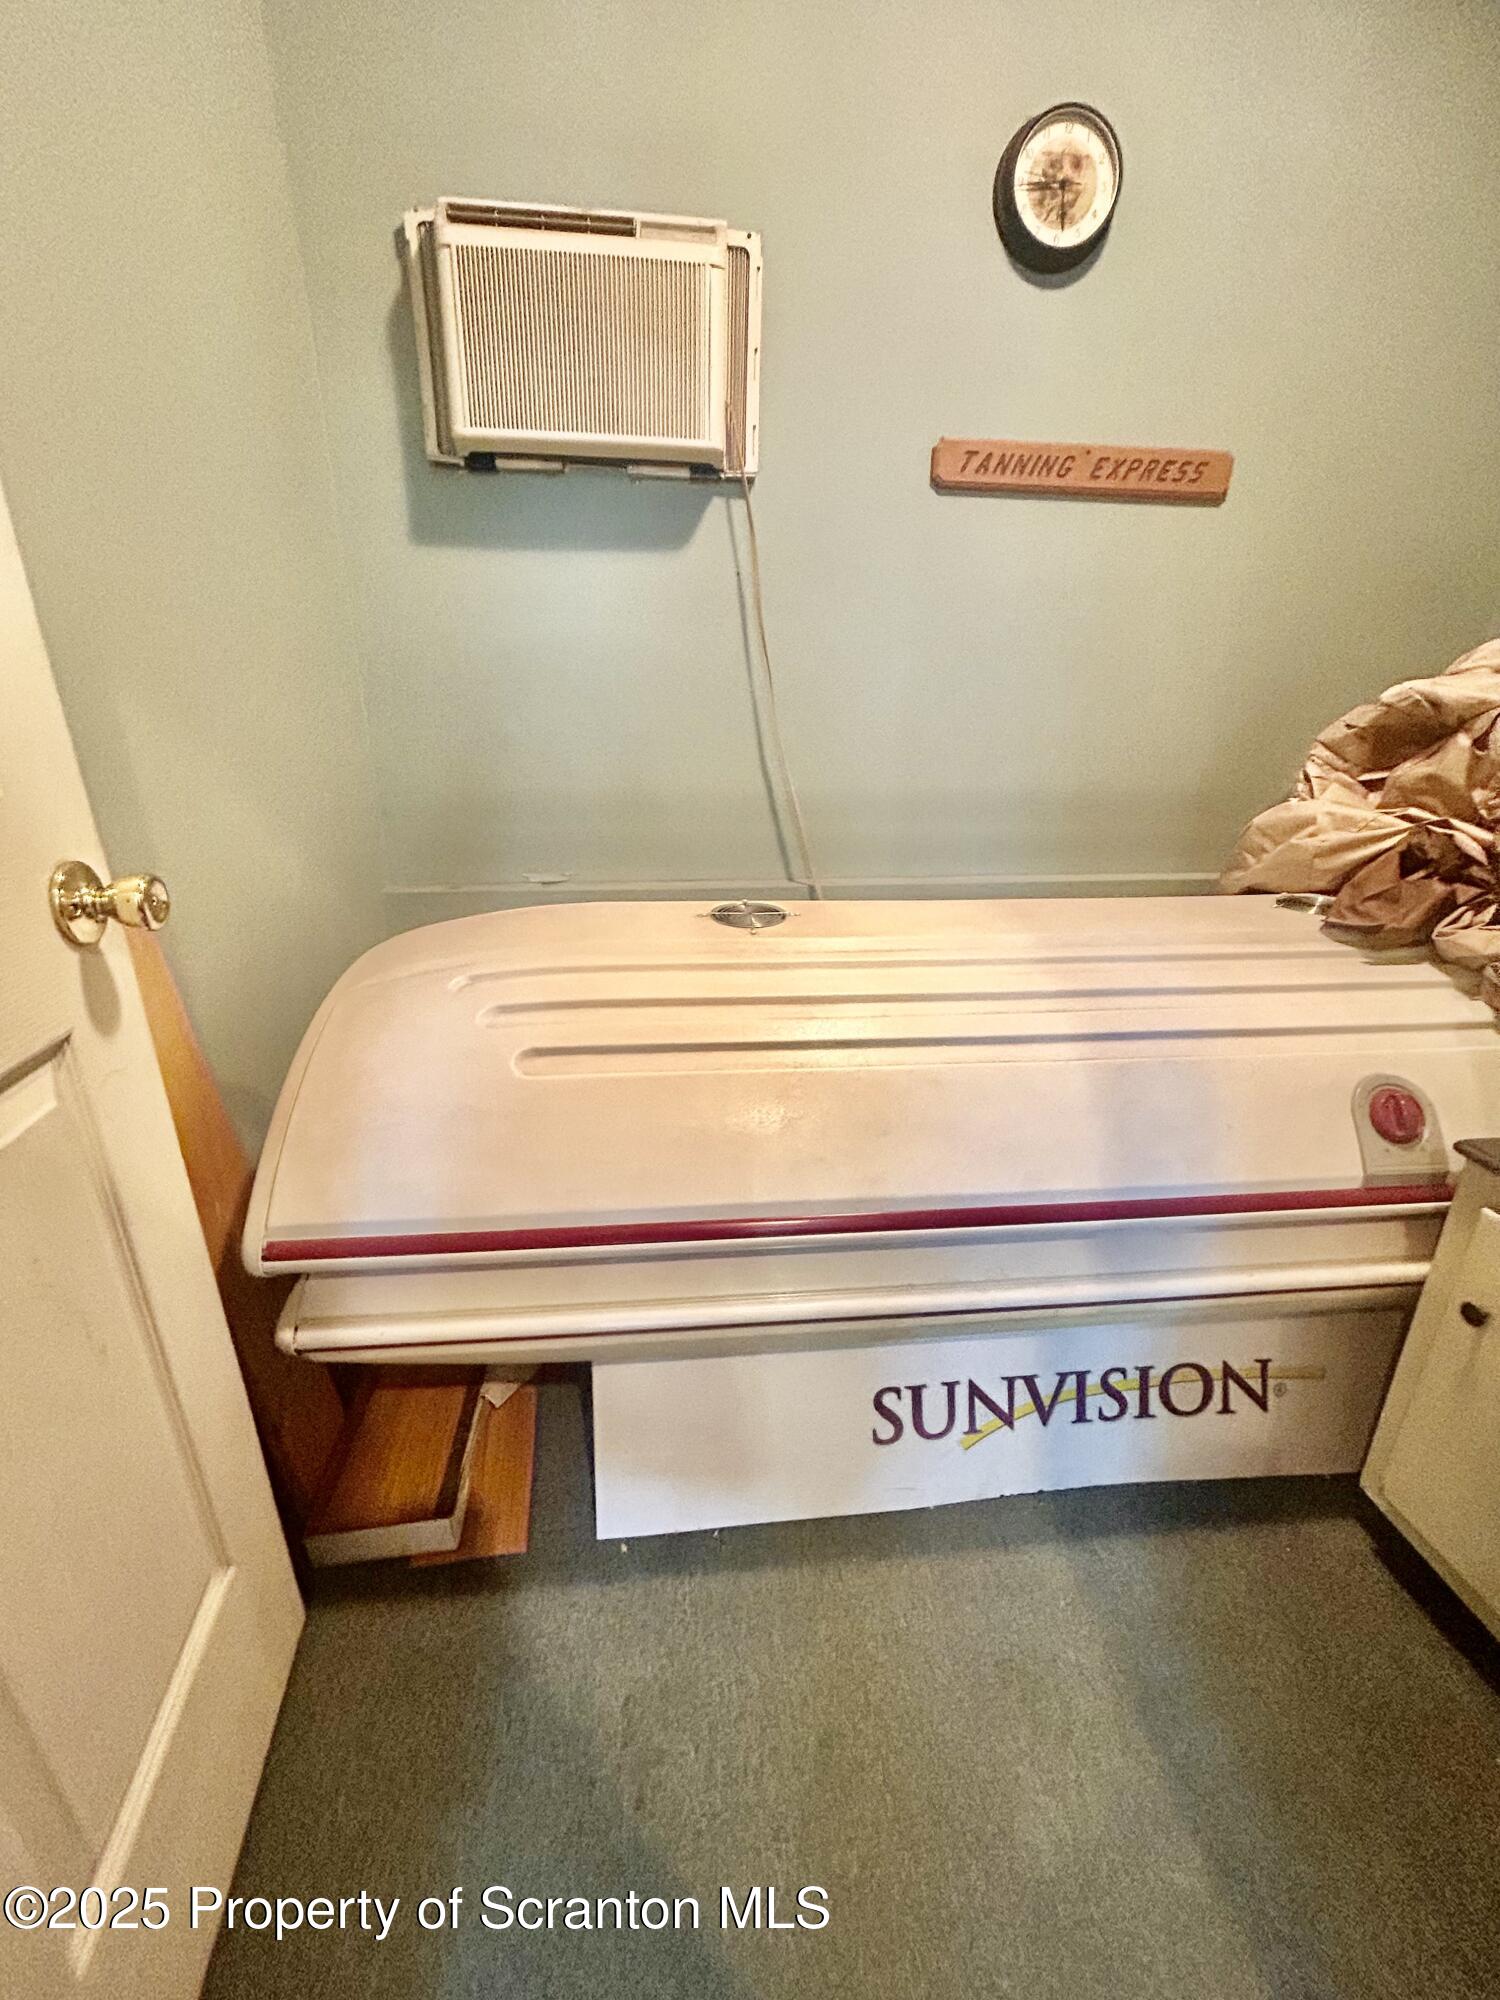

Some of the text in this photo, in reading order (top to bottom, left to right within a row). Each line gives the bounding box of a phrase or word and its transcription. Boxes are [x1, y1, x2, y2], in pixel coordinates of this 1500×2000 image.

[959, 450, 1209, 484] TANNING EXPRESS
[872, 1358, 1273, 1447] SUNVISION
